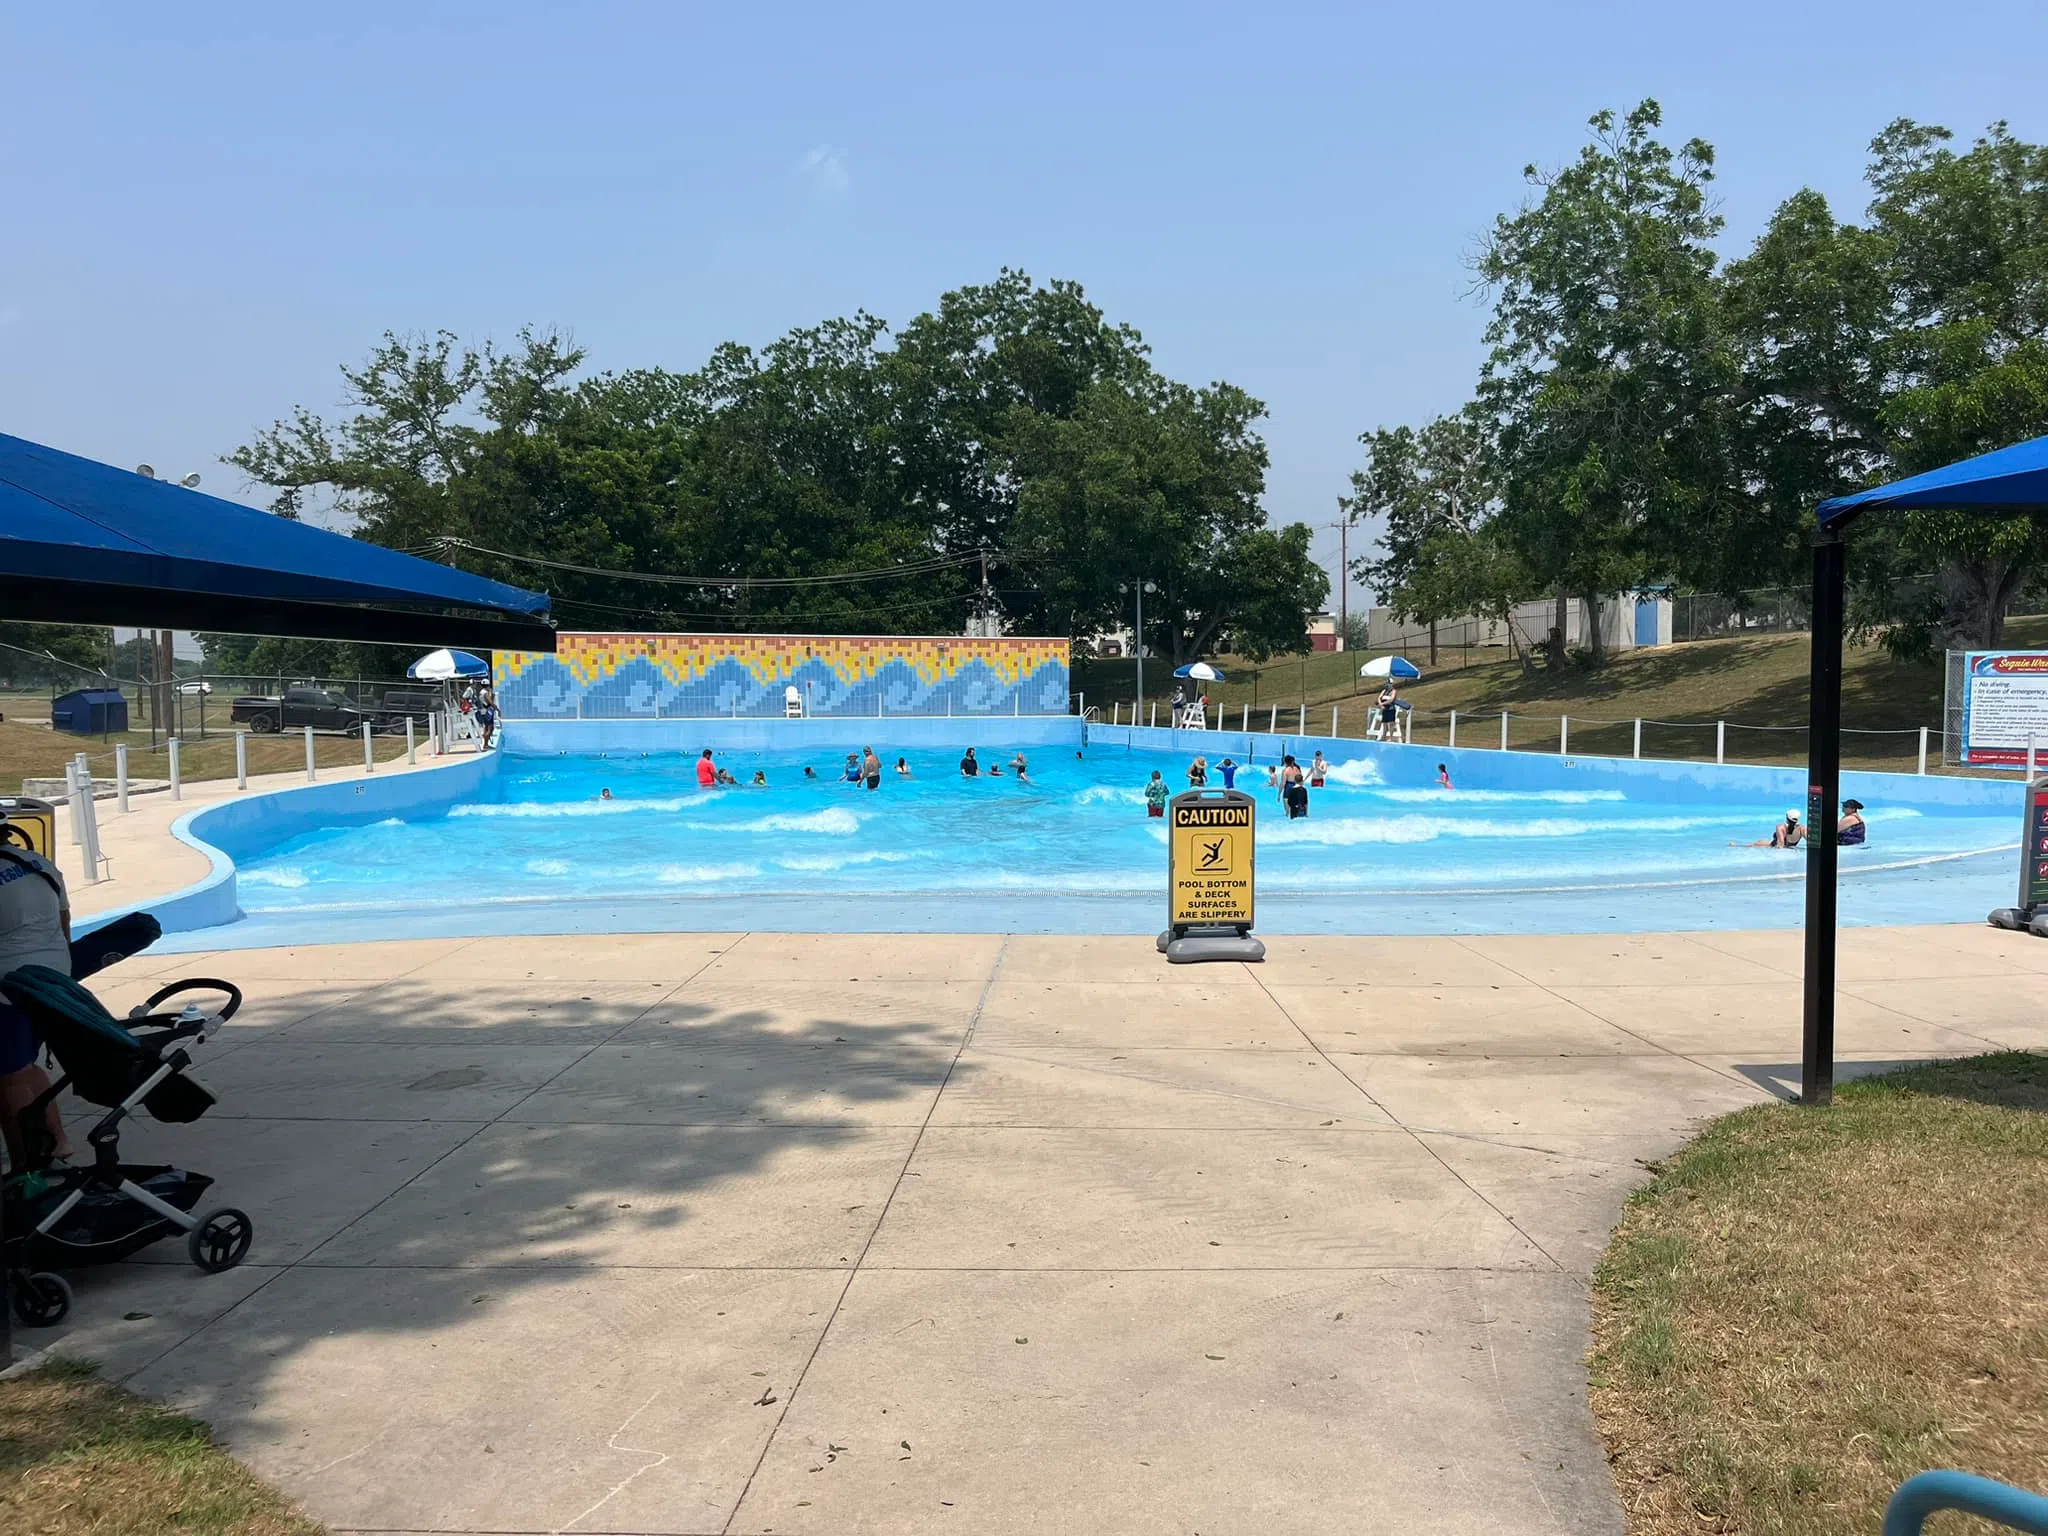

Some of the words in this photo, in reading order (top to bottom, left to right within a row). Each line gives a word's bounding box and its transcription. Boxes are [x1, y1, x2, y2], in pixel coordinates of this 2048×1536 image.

[1999, 659, 2030, 671] Seguin
[1177, 808, 1247, 825] CAUTION
[1178, 880, 1204, 888] POOL
[1207, 880, 1247, 888] BOTTOM
[1194, 890, 1202, 898] &
[1205, 890, 1231, 898] DECK
[1187, 900, 1237, 908] SURFACES
[1178, 911, 1198, 919] ARE
[1200, 910, 1246, 919] SLIPPERY
